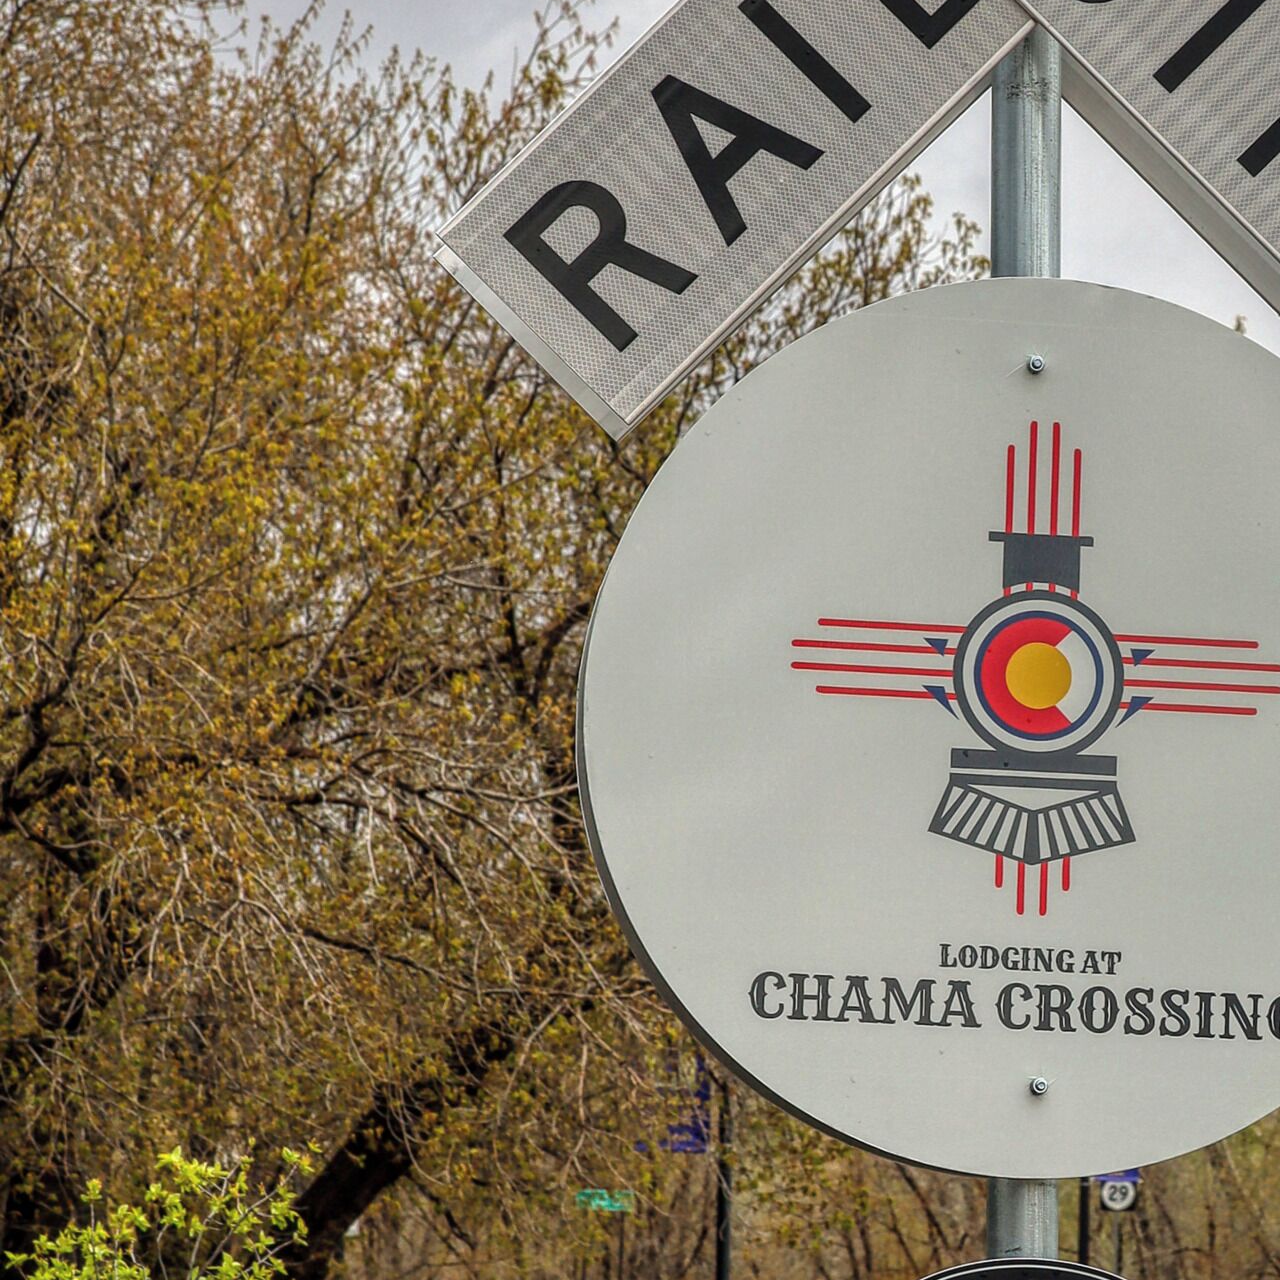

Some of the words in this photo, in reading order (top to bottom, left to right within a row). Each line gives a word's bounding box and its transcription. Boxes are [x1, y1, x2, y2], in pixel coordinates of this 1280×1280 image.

[938, 943, 1076, 974] LODGING
[1079, 950, 1122, 976] AT
[748, 971, 983, 1028] CHAMA
[1108, 1184, 1129, 1202] 29
